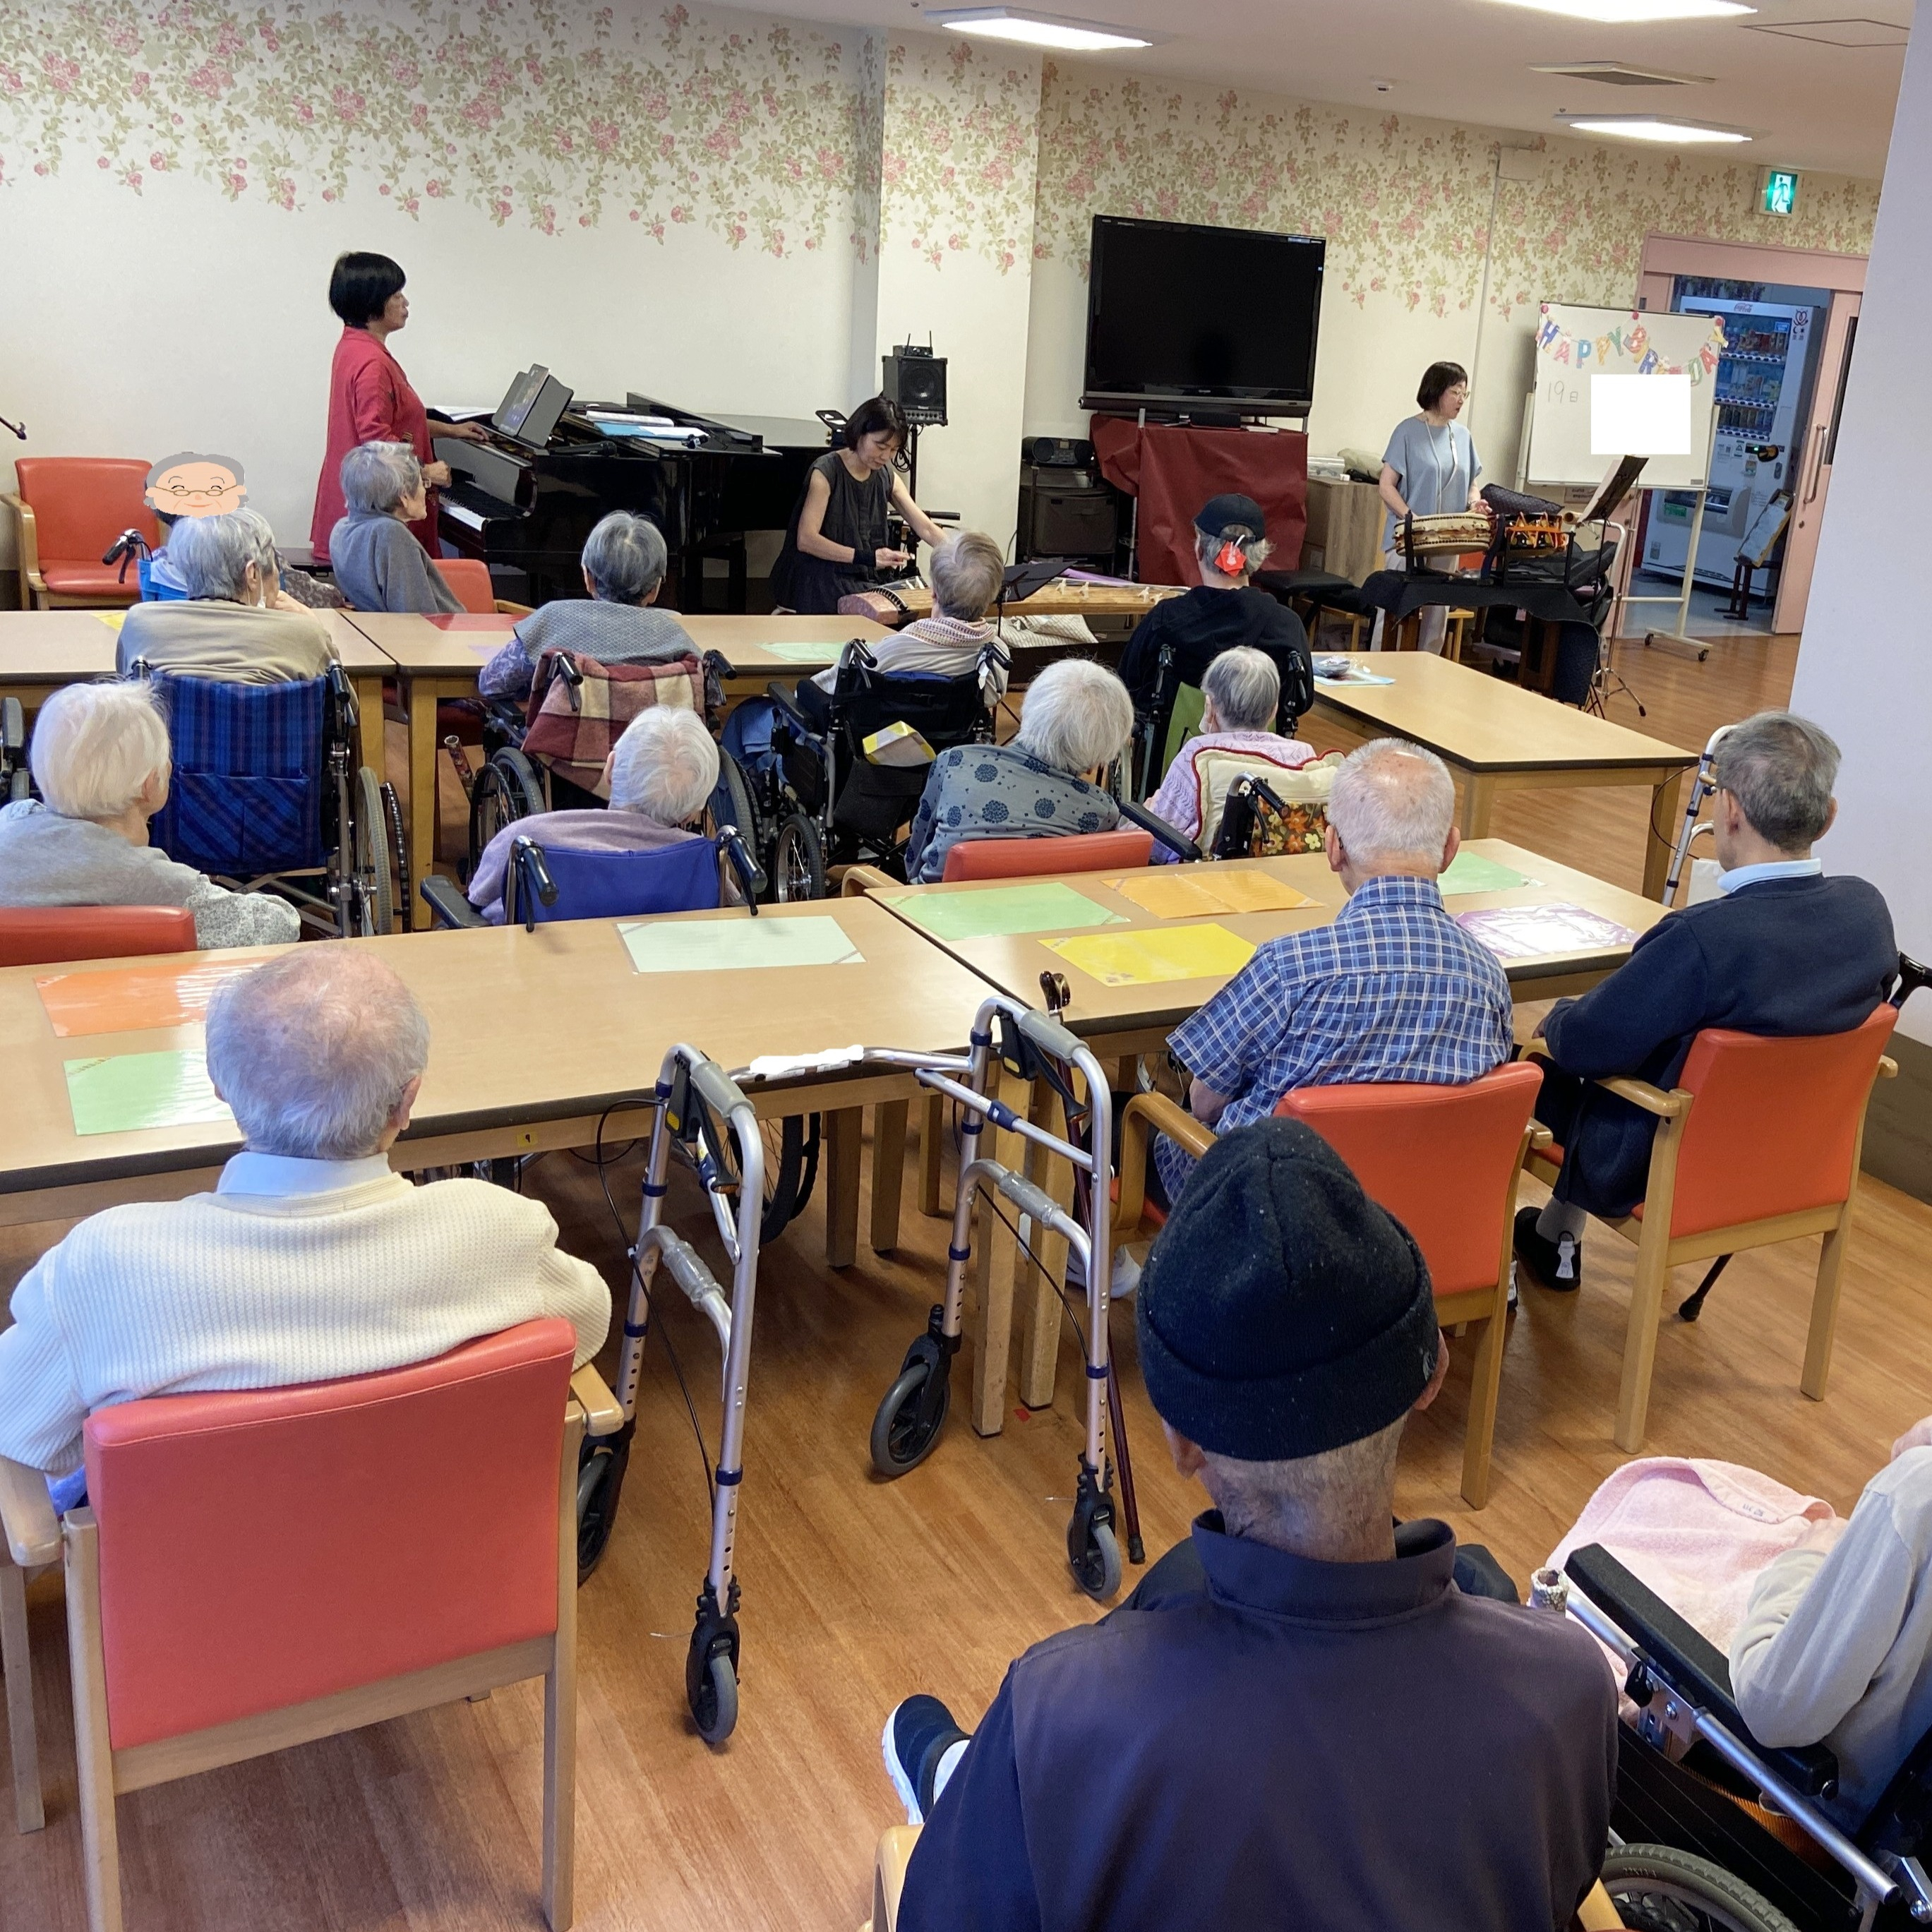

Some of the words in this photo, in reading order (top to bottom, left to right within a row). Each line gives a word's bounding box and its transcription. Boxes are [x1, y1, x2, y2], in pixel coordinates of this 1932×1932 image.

[1539, 320, 1624, 368] HAPPY
[1624, 325, 1727, 387] BIRDAY
[1547, 380, 1578, 403] 19日
